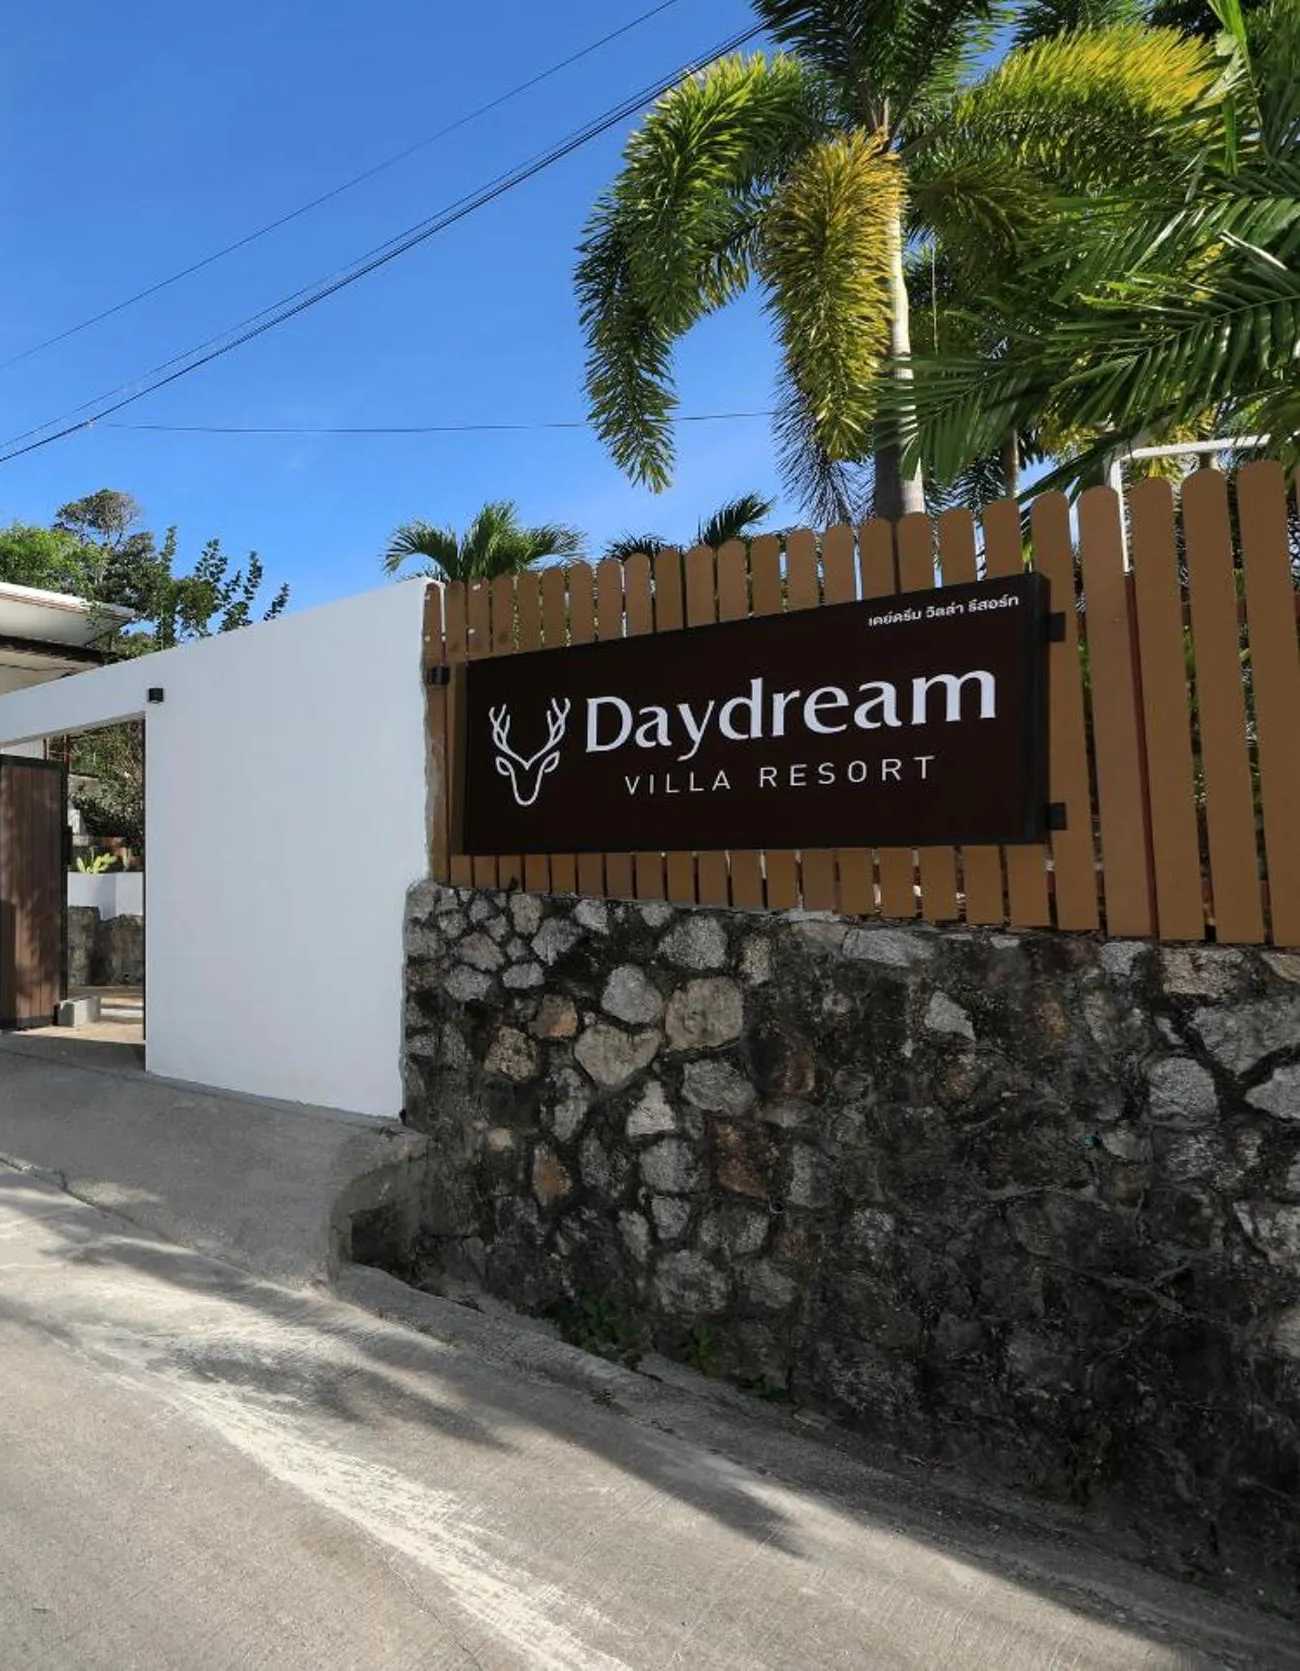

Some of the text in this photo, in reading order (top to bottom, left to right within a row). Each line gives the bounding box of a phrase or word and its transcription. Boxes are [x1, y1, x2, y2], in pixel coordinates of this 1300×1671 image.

[585, 670, 996, 762] Daydream
[624, 755, 935, 795] VILLA RESORT
